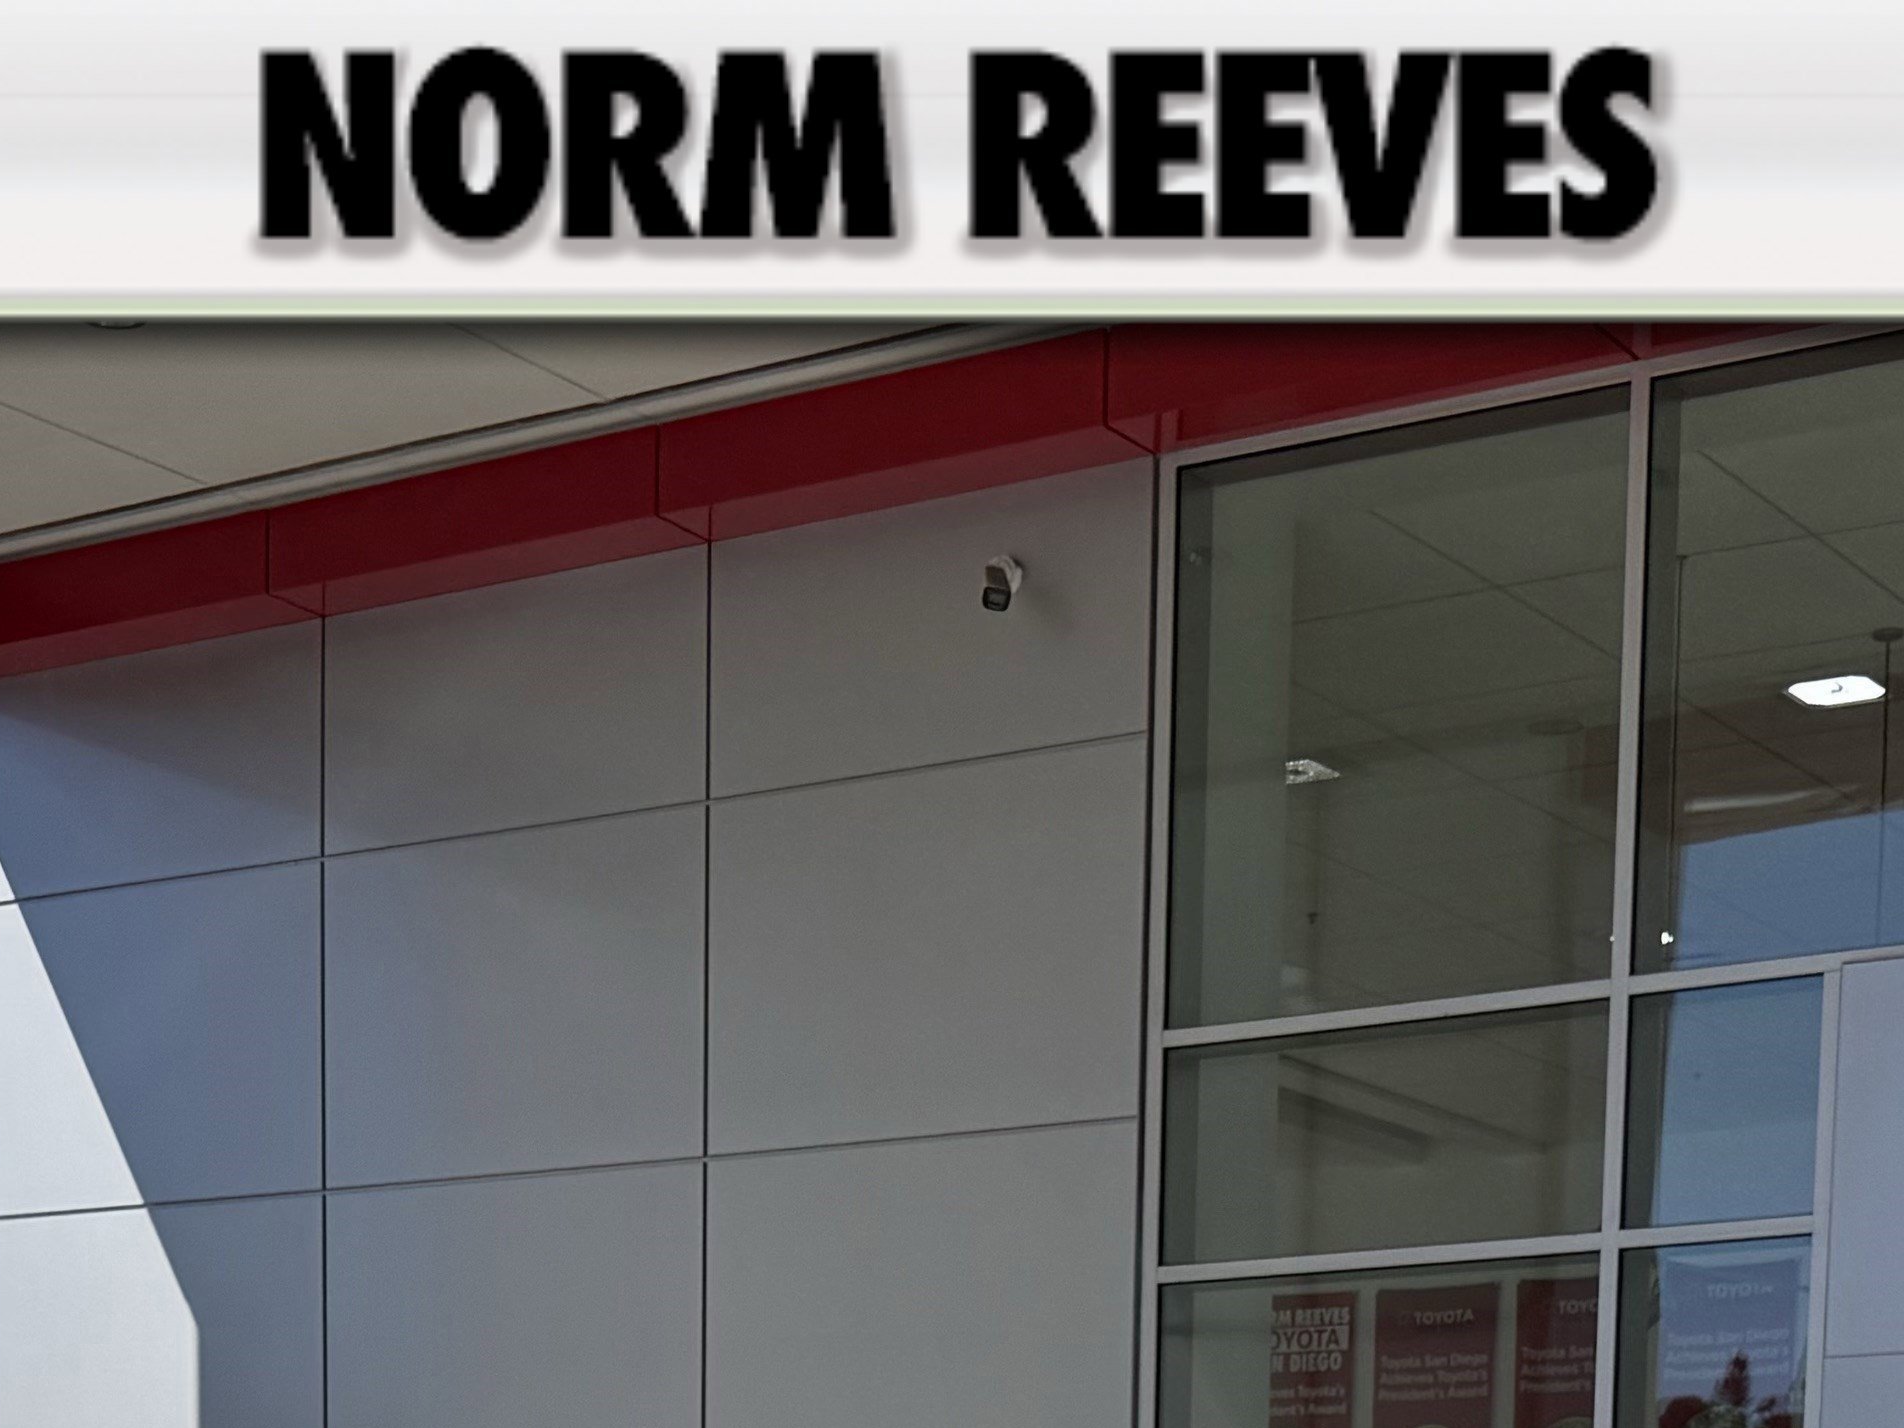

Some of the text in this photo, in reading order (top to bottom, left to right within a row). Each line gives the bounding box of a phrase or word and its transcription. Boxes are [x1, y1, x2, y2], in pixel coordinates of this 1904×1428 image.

[1414, 1308, 1474, 1325] TOYOTA
[1271, 1329, 1340, 1350] OYOTA
[1290, 1352, 1342, 1373] DIEGO
